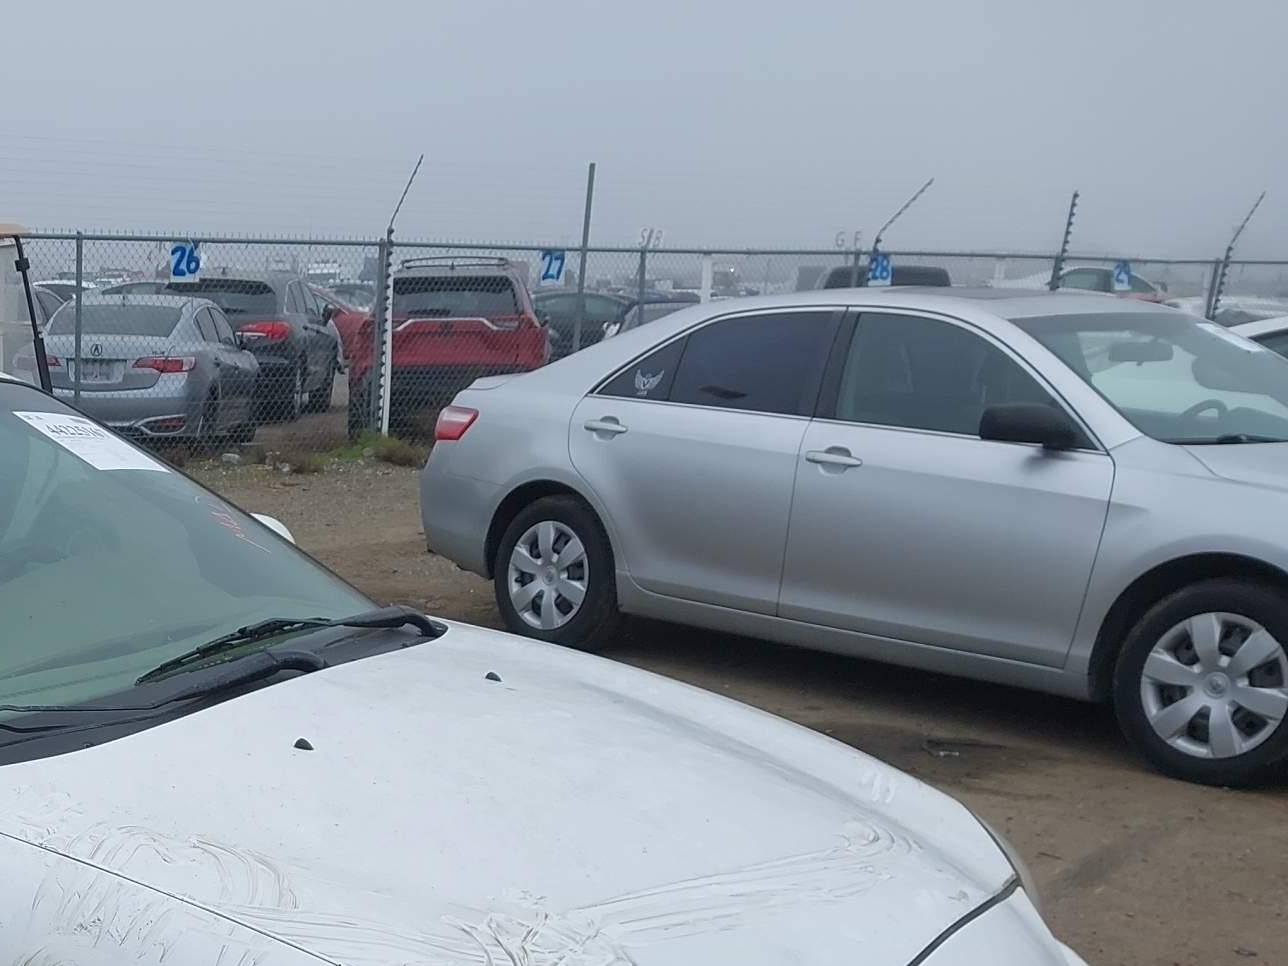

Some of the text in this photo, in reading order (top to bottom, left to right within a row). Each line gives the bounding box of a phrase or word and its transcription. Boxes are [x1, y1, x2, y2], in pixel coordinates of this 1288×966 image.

[171, 246, 200, 276] 26
[541, 251, 565, 281] 27
[870, 254, 890, 280] 28
